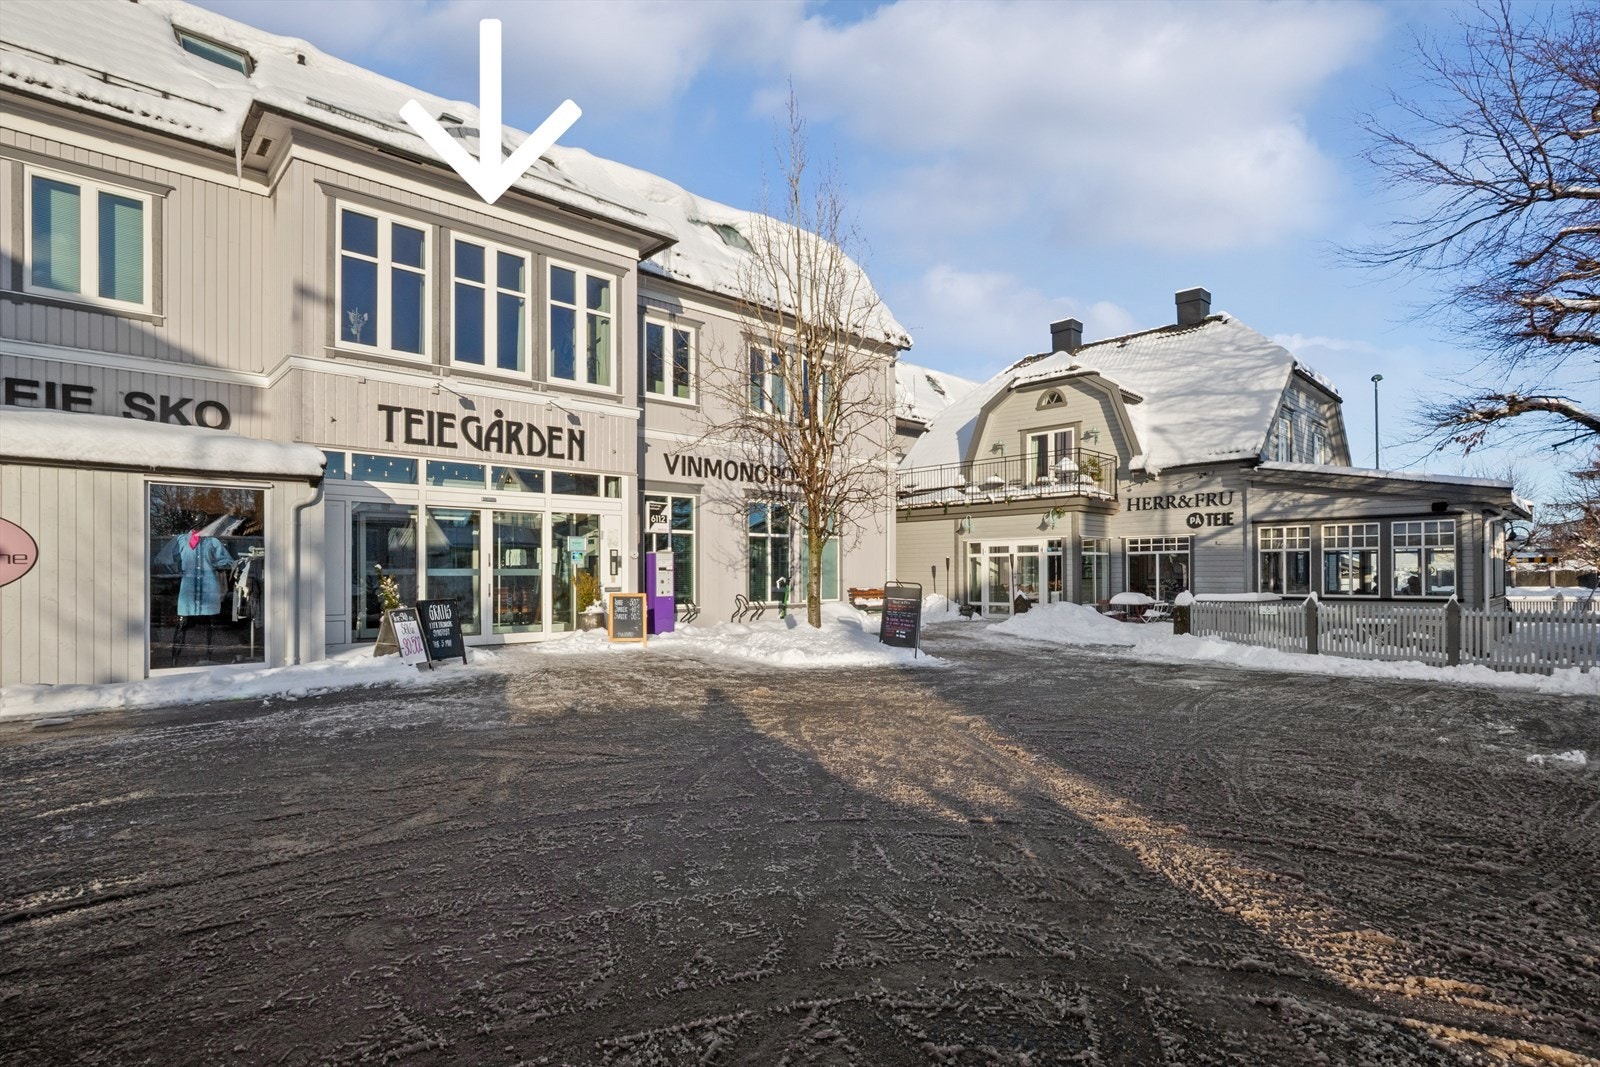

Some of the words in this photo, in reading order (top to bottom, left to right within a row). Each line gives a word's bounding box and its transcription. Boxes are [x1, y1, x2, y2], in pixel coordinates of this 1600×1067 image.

[122, 391, 231, 430] SKO
[377, 404, 586, 462] TEIEGÅRDEN
[1126, 491, 1235, 512] HERR&FRU
[650, 514, 666, 523] 6112
[1205, 512, 1234, 527] TEIE
